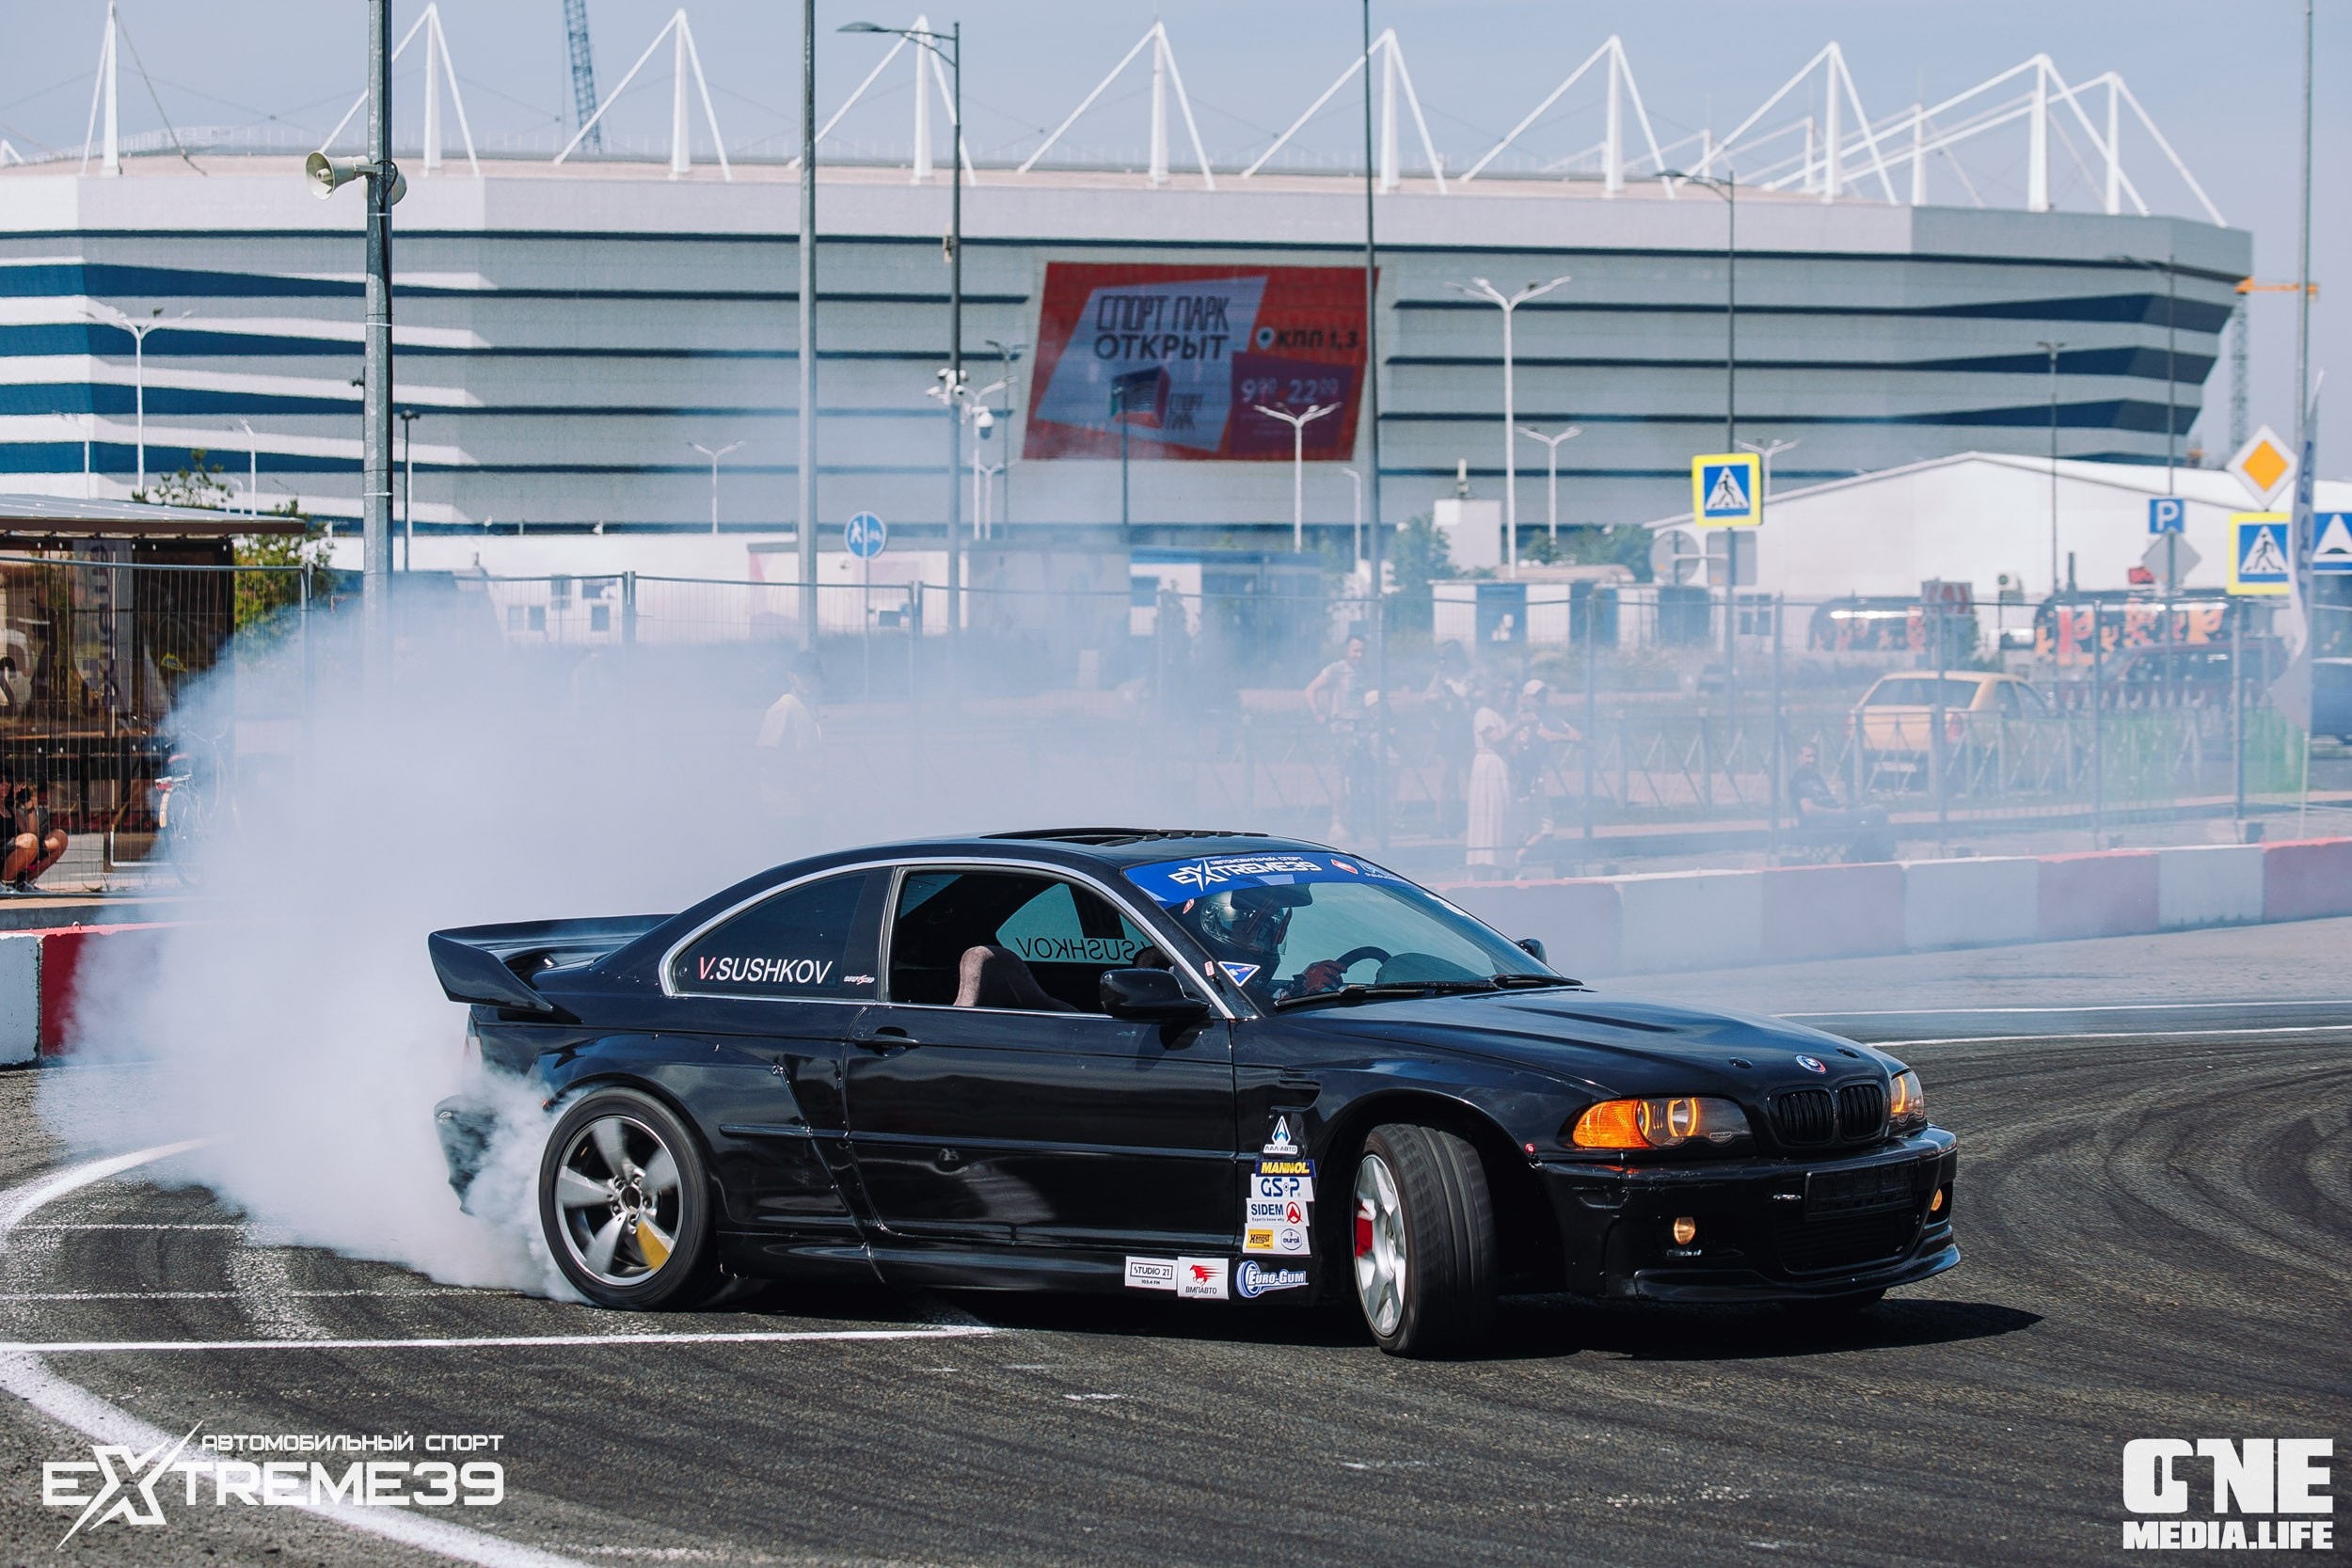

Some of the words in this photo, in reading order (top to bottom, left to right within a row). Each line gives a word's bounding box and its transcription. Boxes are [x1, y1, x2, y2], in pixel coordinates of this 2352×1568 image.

[1171, 295, 1231, 331] ПАРК
[1094, 333, 1230, 360] ОТКРЫТ
[1277, 329, 1324, 348] КПП
[2157, 501, 2180, 531] P
[1168, 859, 1323, 893] EXTREME39
[700, 957, 833, 984] V.SUSHKOV
[1261, 1162, 1310, 1174] MANNOL
[1251, 1203, 1284, 1215] SIDEM
[1134, 1266, 1161, 1275] STUDIO
[1162, 1268, 1170, 1276] 21
